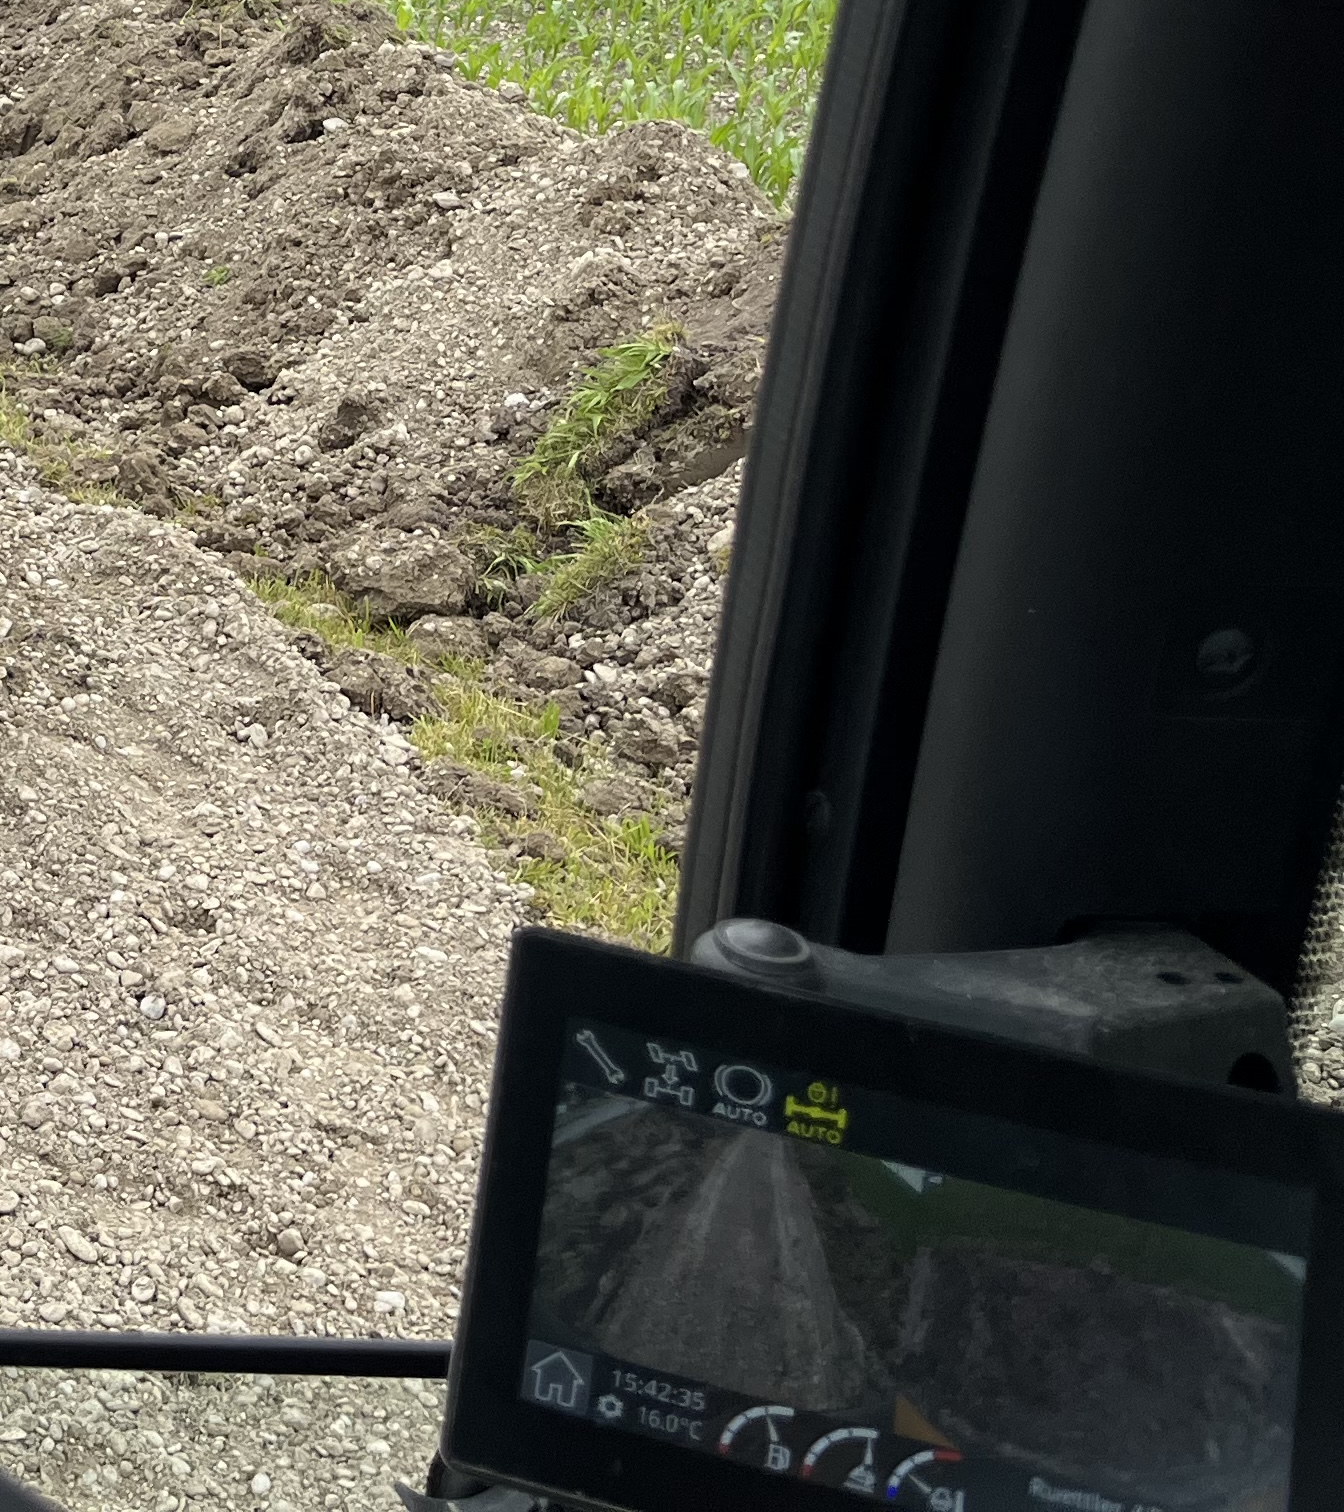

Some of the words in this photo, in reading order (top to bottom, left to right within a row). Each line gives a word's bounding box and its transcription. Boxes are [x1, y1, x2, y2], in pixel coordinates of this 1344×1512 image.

[712, 1101, 767, 1127] AUTO
[786, 1120, 843, 1145] AUTO
[612, 1369, 706, 1411] 15:42:35
